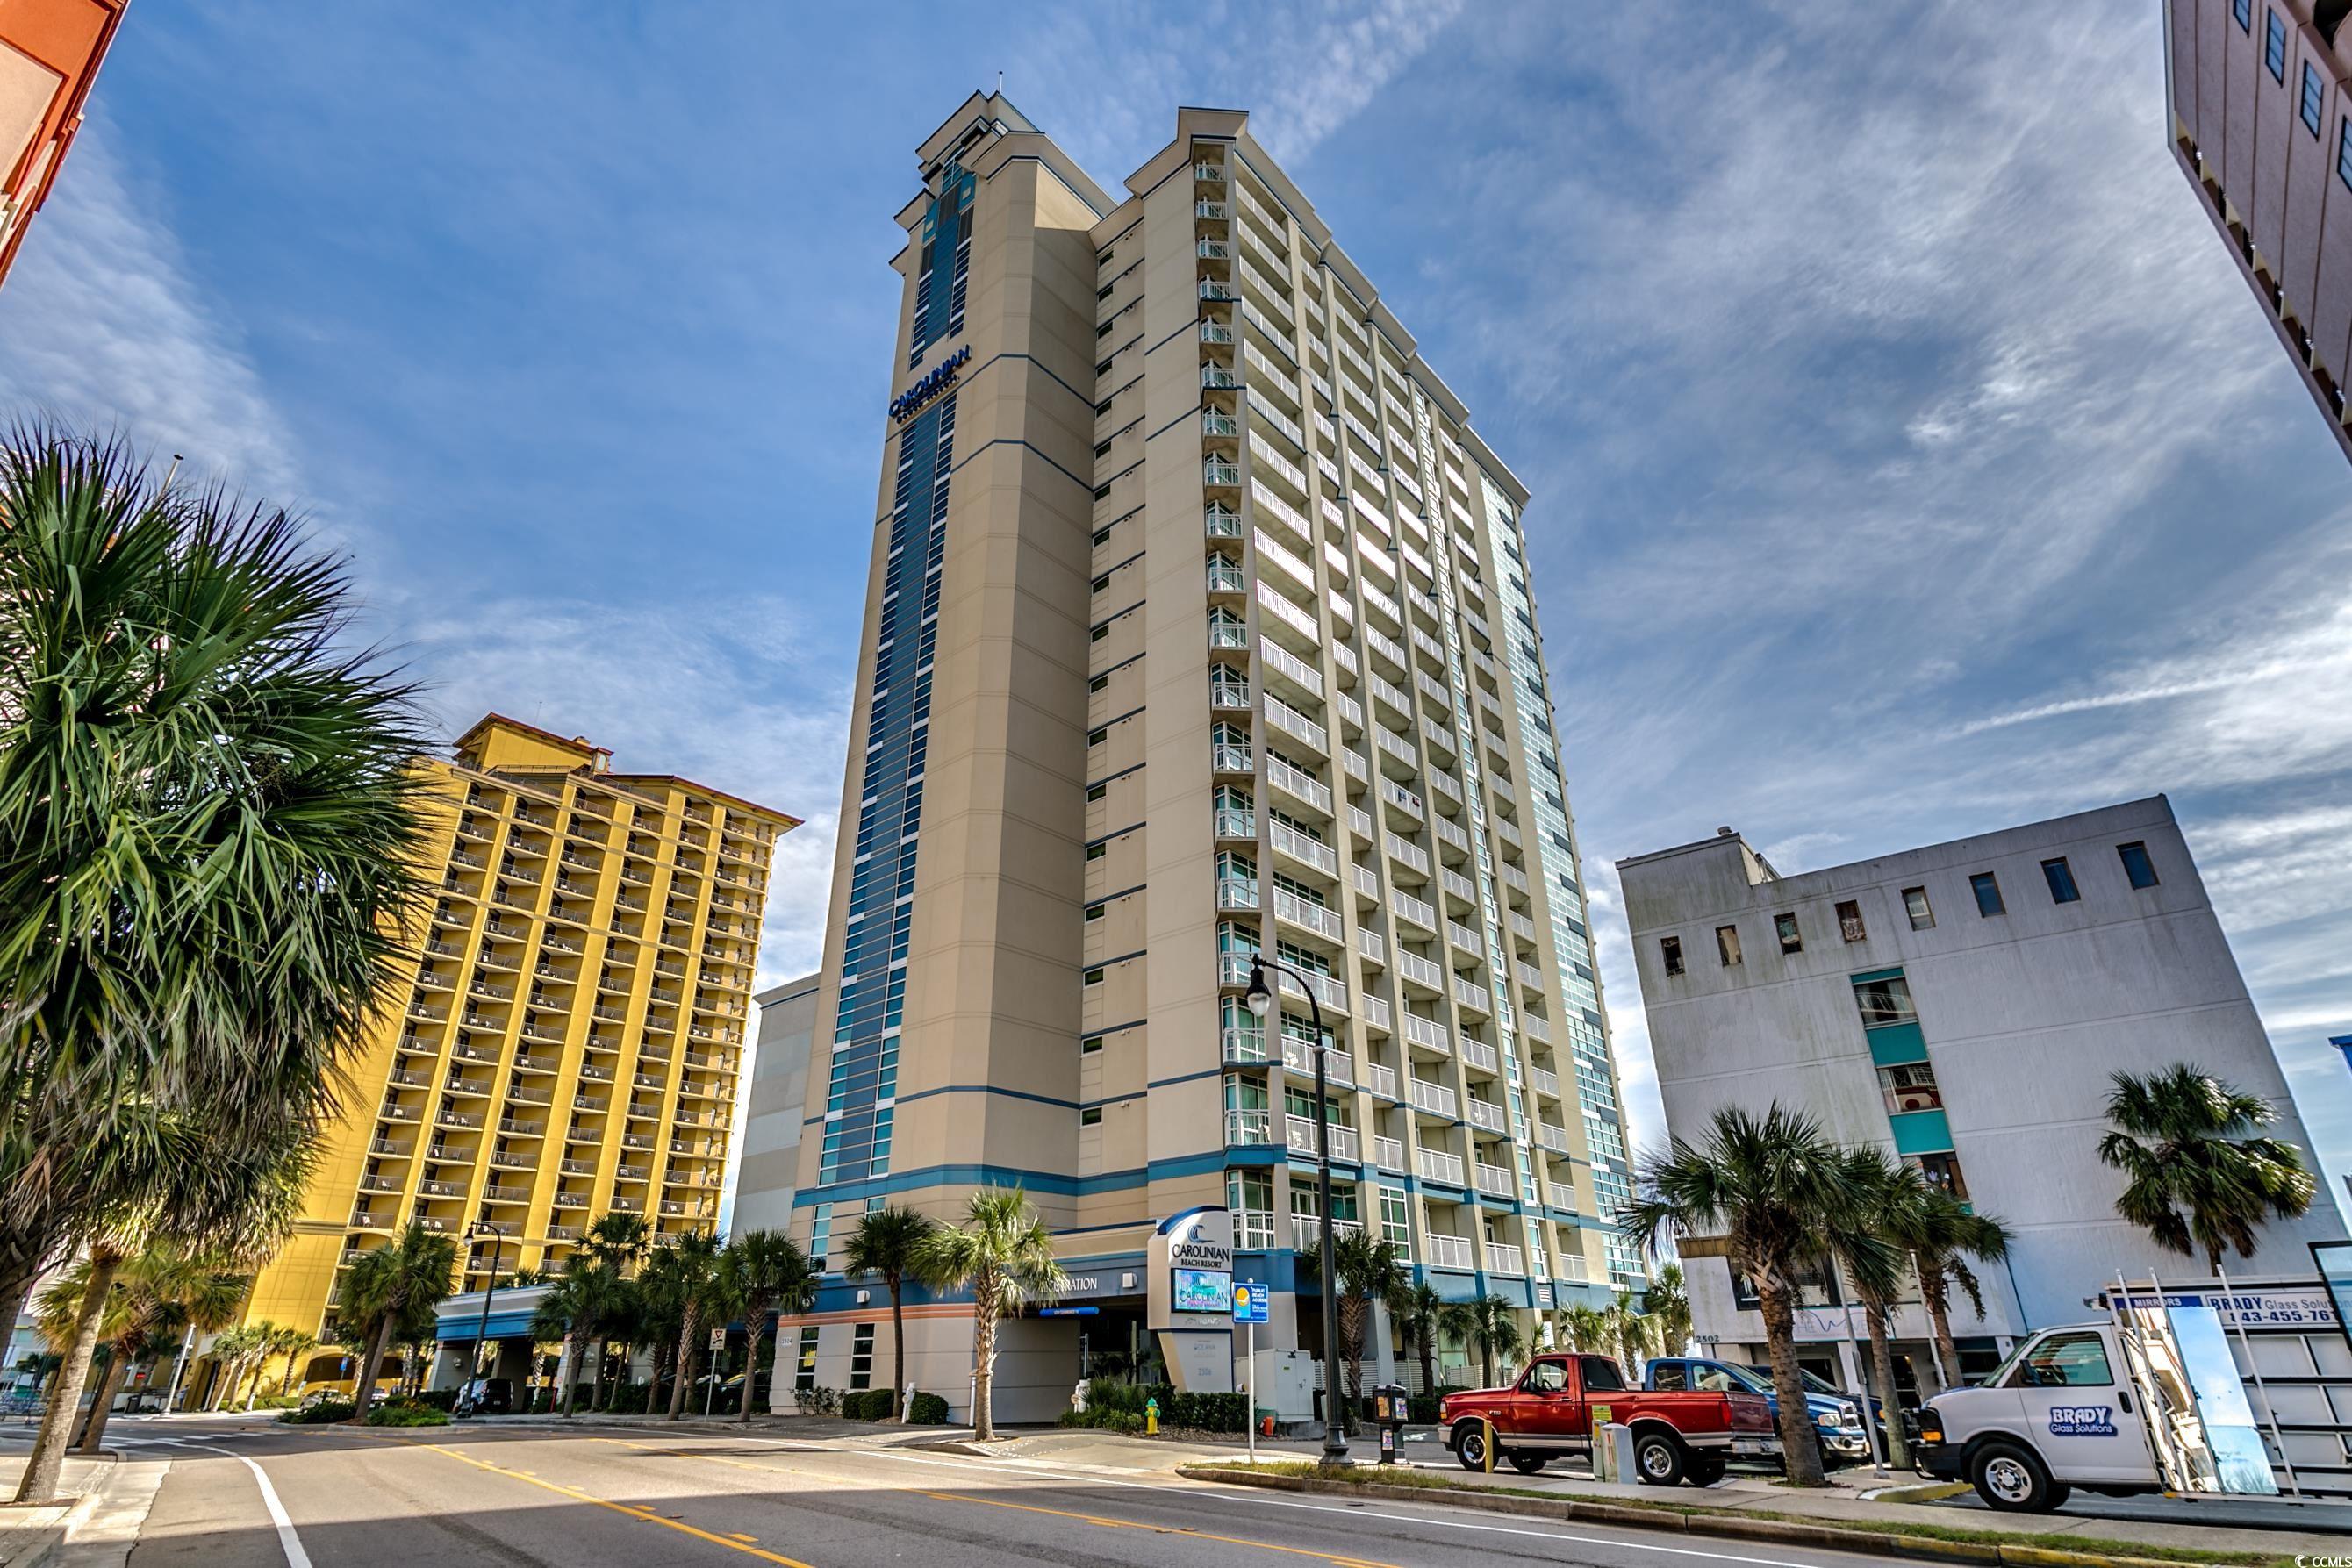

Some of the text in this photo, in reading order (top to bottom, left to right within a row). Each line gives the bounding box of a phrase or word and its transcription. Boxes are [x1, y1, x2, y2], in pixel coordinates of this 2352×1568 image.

[1172, 1244, 1230, 1262] CAROLINIAN
[1180, 1290, 1228, 1304] CAROLINIAN
[2210, 1297, 2262, 1310] BRADY
[2265, 1300, 2298, 1309] Glass
[1696, 1335, 1720, 1343] 2502
[2052, 1407, 2107, 1424] BRADY
[2050, 1423, 2112, 1433] Glass Solutions
